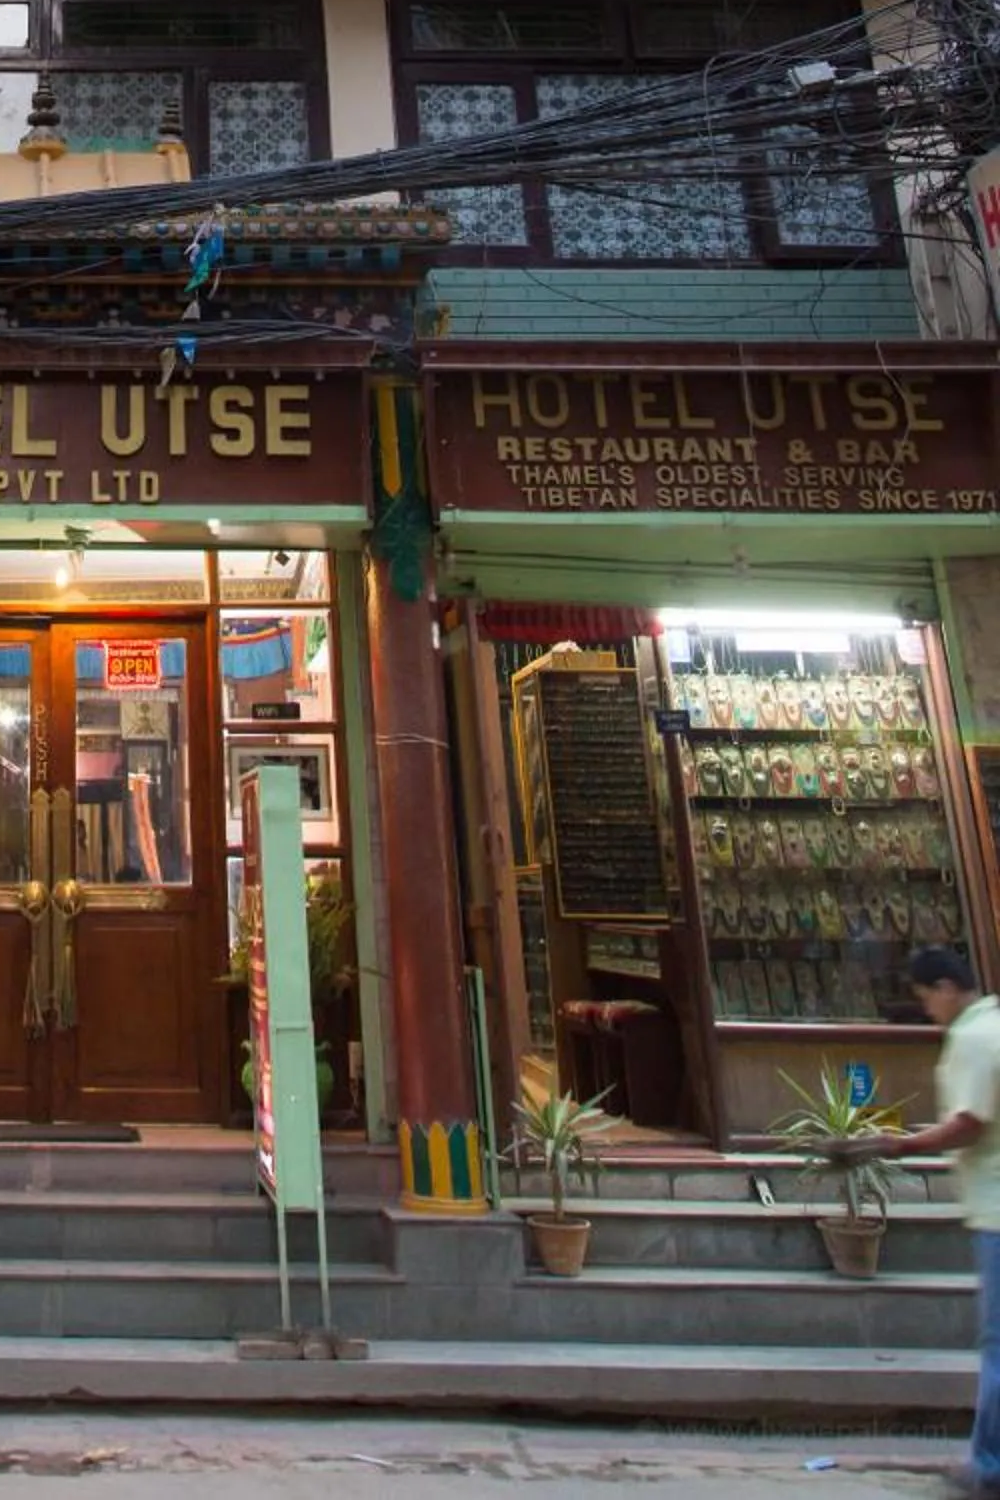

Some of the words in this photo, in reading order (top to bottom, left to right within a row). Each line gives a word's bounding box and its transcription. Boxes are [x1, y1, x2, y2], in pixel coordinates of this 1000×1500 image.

[472, 370, 715, 428] HOTEL
[742, 371, 944, 431] UTSE
[101, 385, 312, 455] UTSE
[497, 436, 757, 463] RESTAURANT
[787, 439, 813, 463] &
[836, 439, 920, 463] BAR
[91, 471, 161, 502] LTD
[784, 466, 905, 486] SERVING
[522, 487, 637, 507] TIBETAN
[656, 487, 841, 508] SPECIALITIES
[858, 489, 939, 509] SINCE
[947, 490, 998, 509] 1971
[111, 658, 153, 674] OPEN
